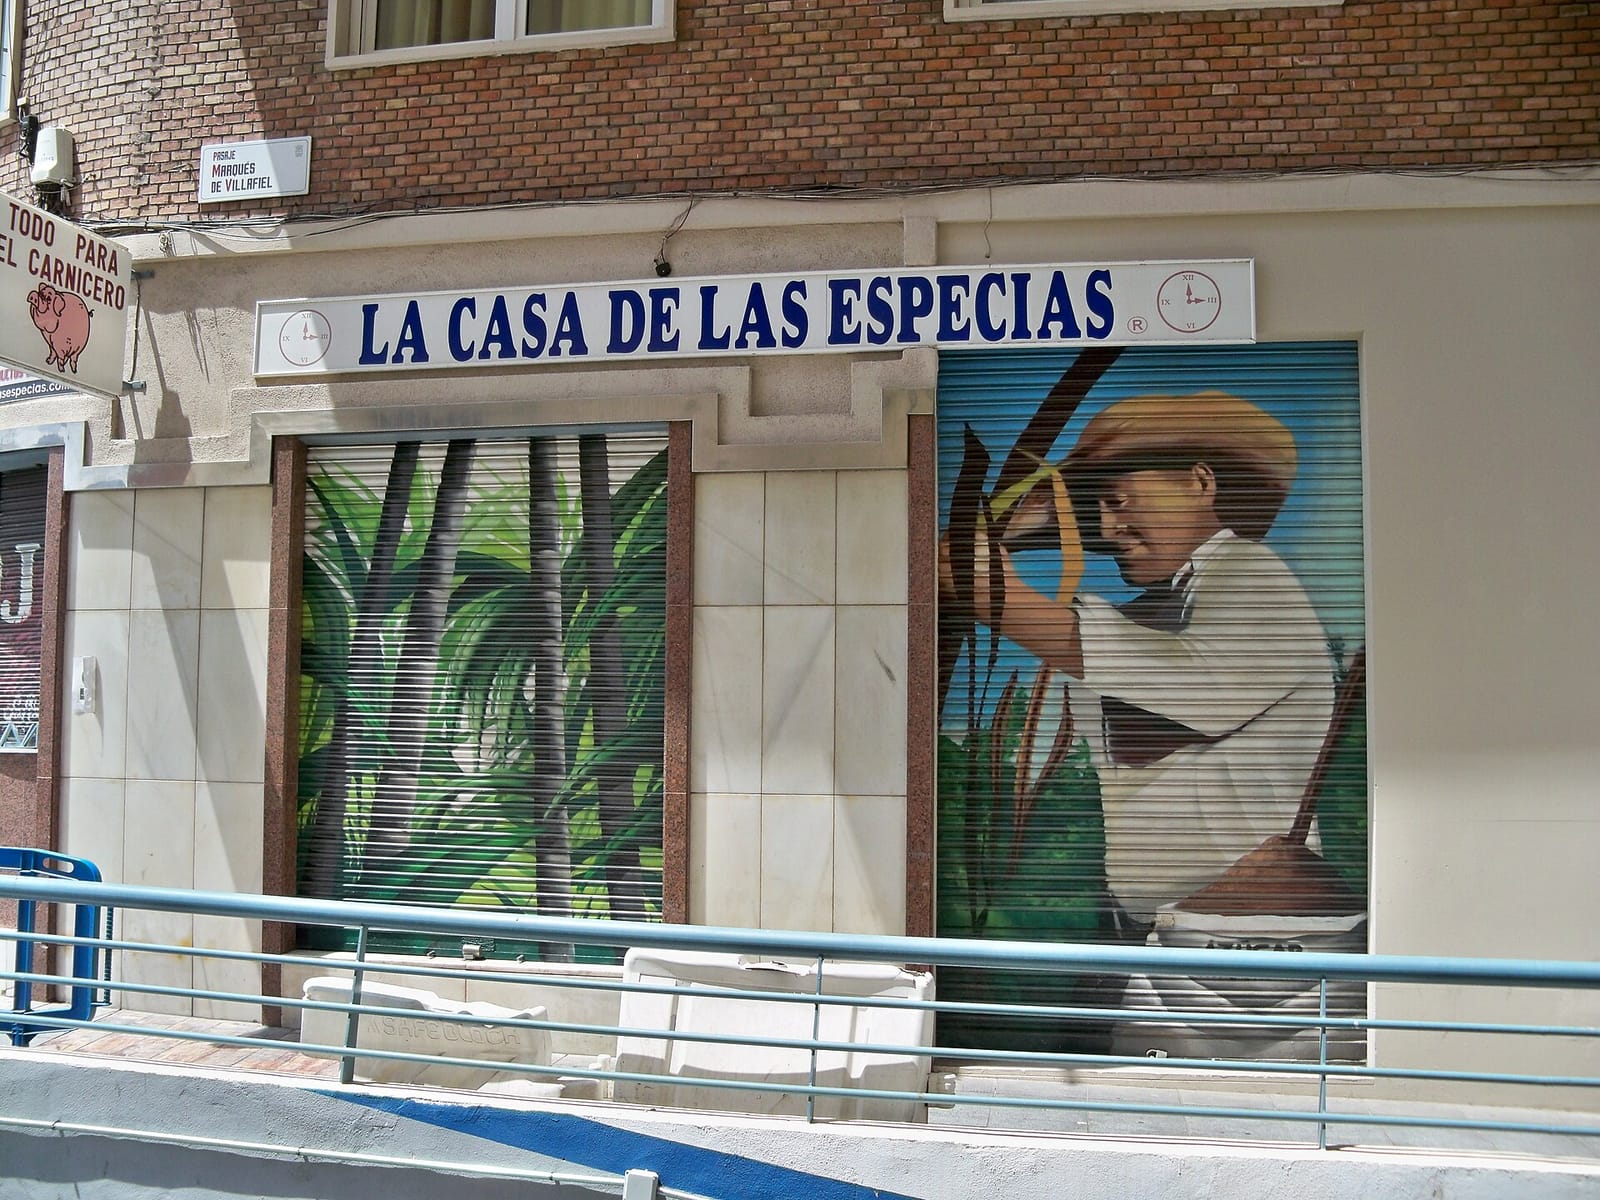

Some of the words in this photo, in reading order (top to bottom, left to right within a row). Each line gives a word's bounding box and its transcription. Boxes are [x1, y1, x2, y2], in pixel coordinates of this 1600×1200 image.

[211, 181, 221, 193] DE
[225, 176, 272, 192] VILLAFIEL
[213, 150, 236, 161] PASAJE
[9, 202, 55, 247] TODO
[75, 233, 118, 276] PARA
[28, 248, 125, 311] CARNICERO
[358, 300, 430, 366] LA
[448, 291, 589, 362] CASA
[606, 287, 681, 354] DE
[697, 279, 809, 351] LAS
[826, 269, 1115, 346] ESPECIAS
